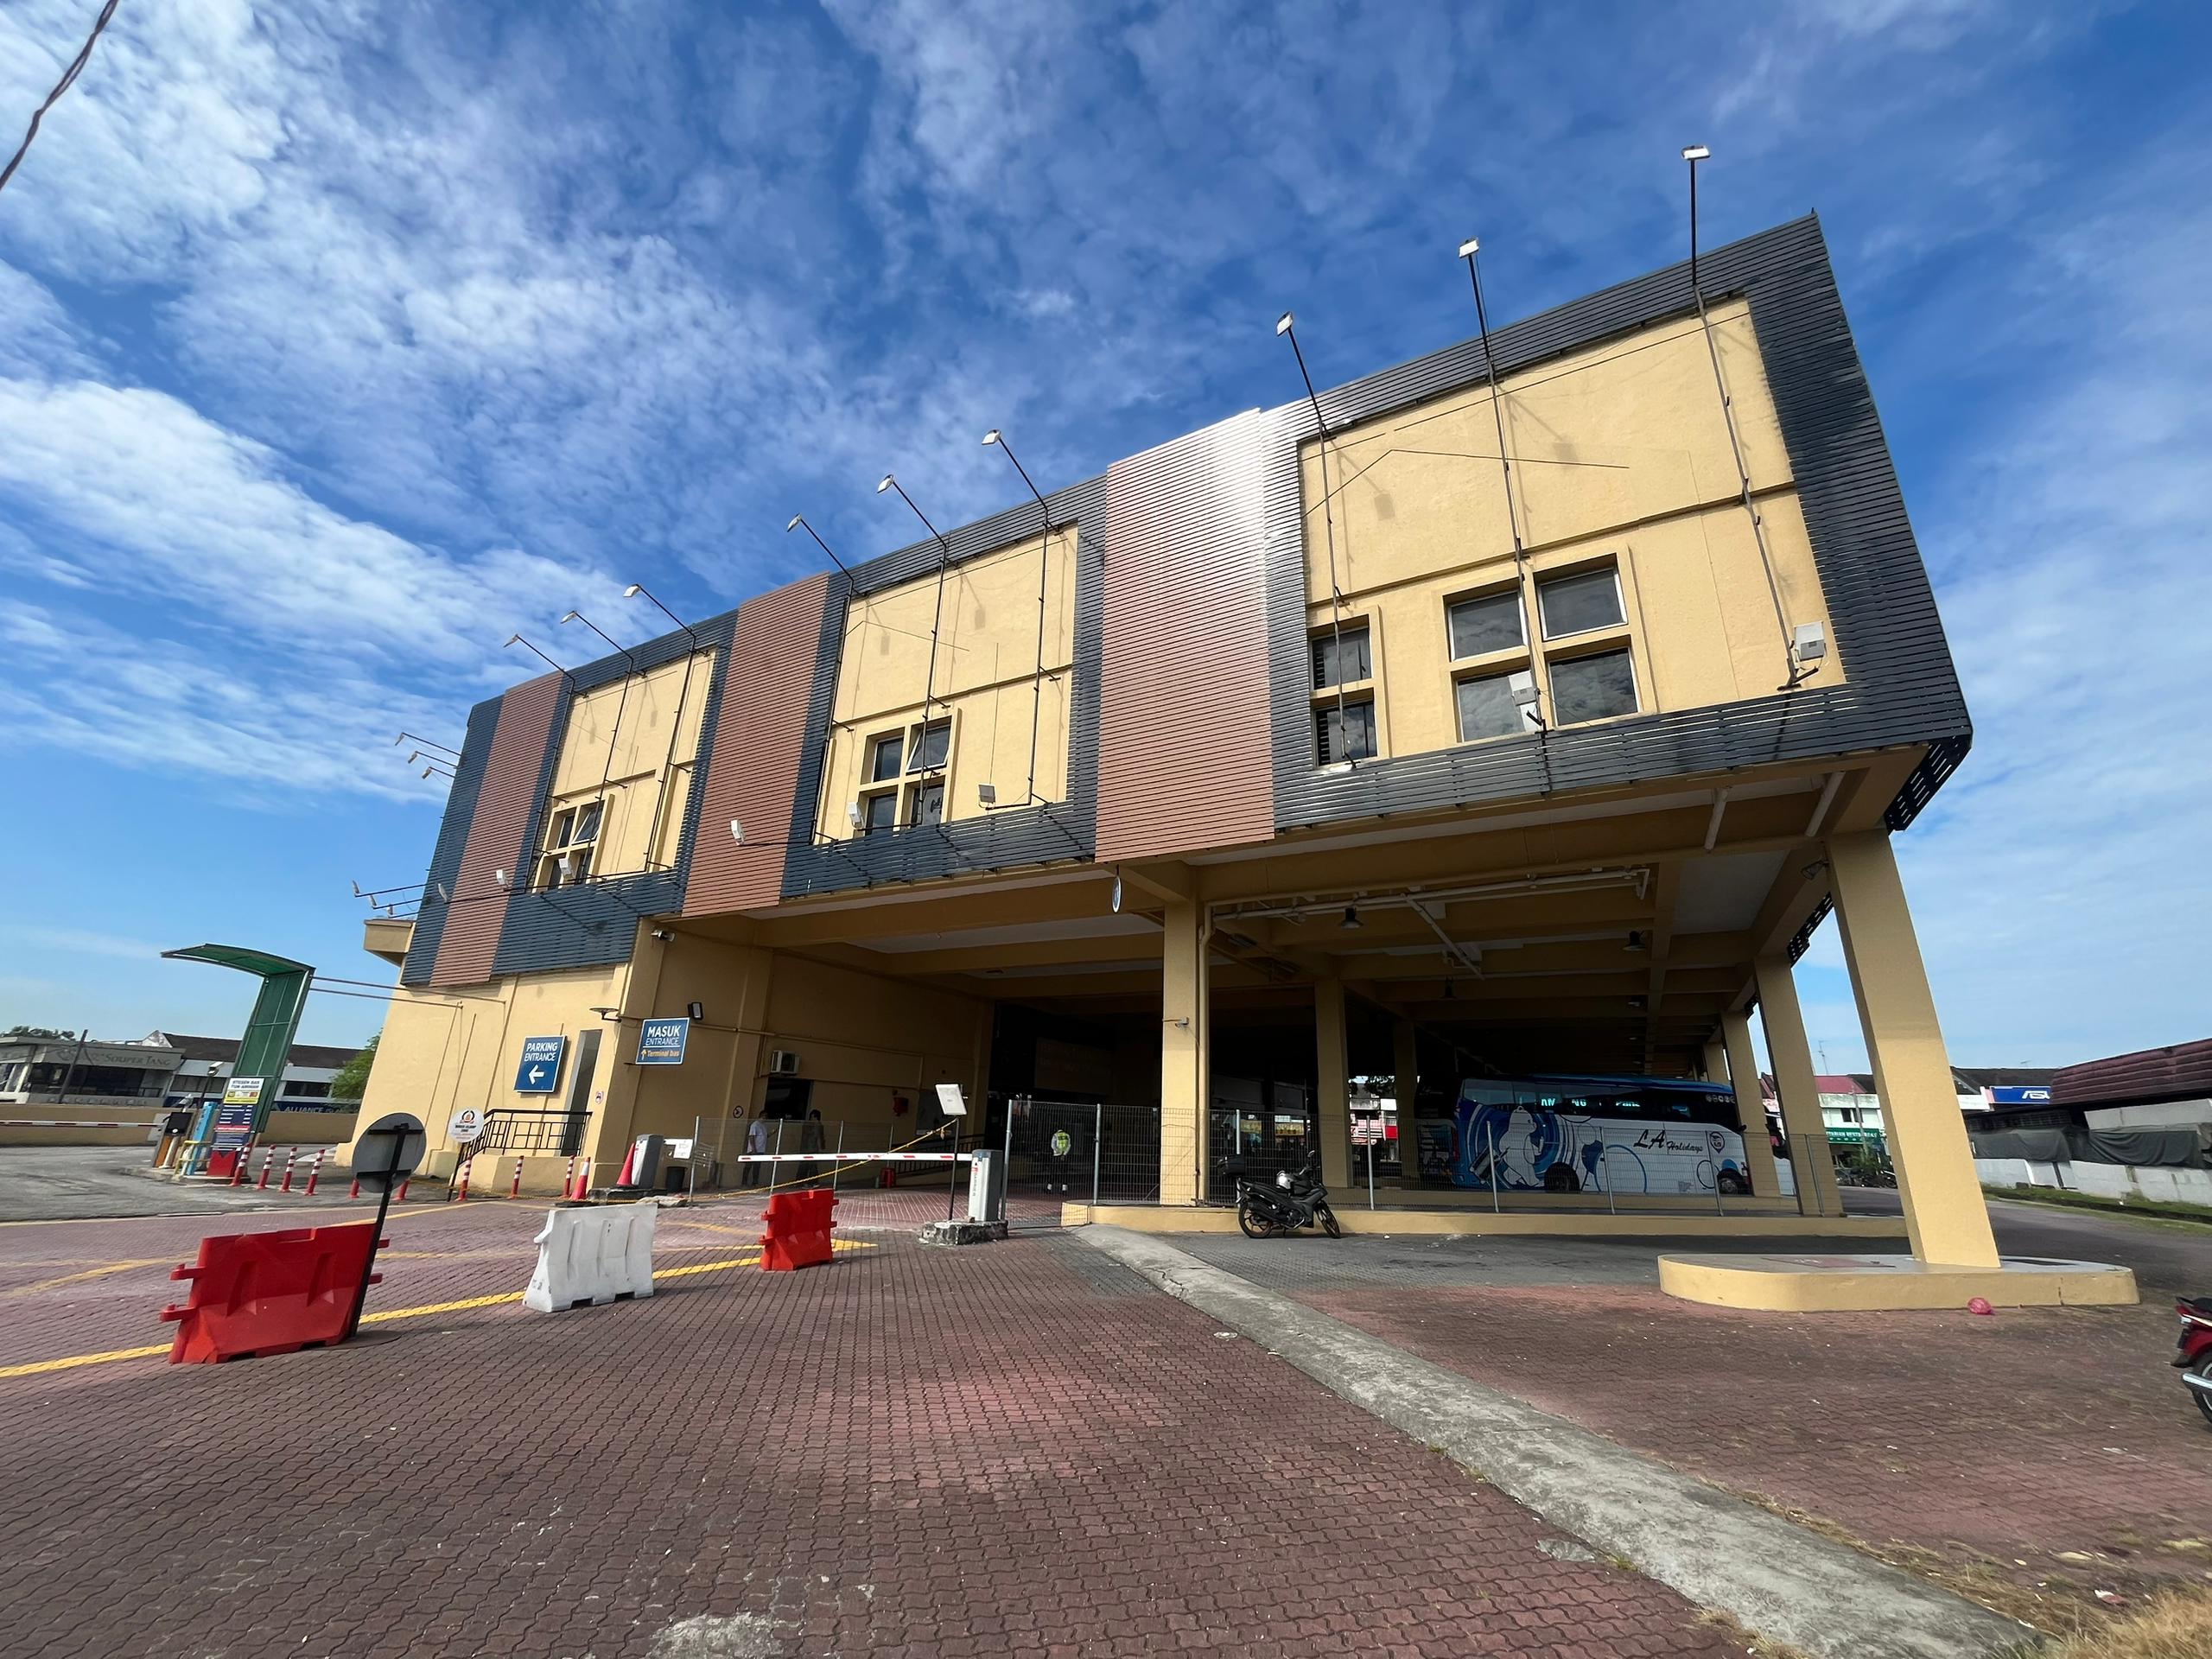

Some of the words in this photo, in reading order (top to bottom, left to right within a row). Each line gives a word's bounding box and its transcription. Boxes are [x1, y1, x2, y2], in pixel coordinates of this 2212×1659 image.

[647, 1025, 682, 1037] MASUK
[645, 1037, 679, 1046] ENTRANCE
[525, 1042, 558, 1052] PARKING
[524, 1052, 556, 1062] ENTRANCE
[1633, 1128, 1666, 1149] LA
[1666, 1141, 1703, 1154] Holidays
